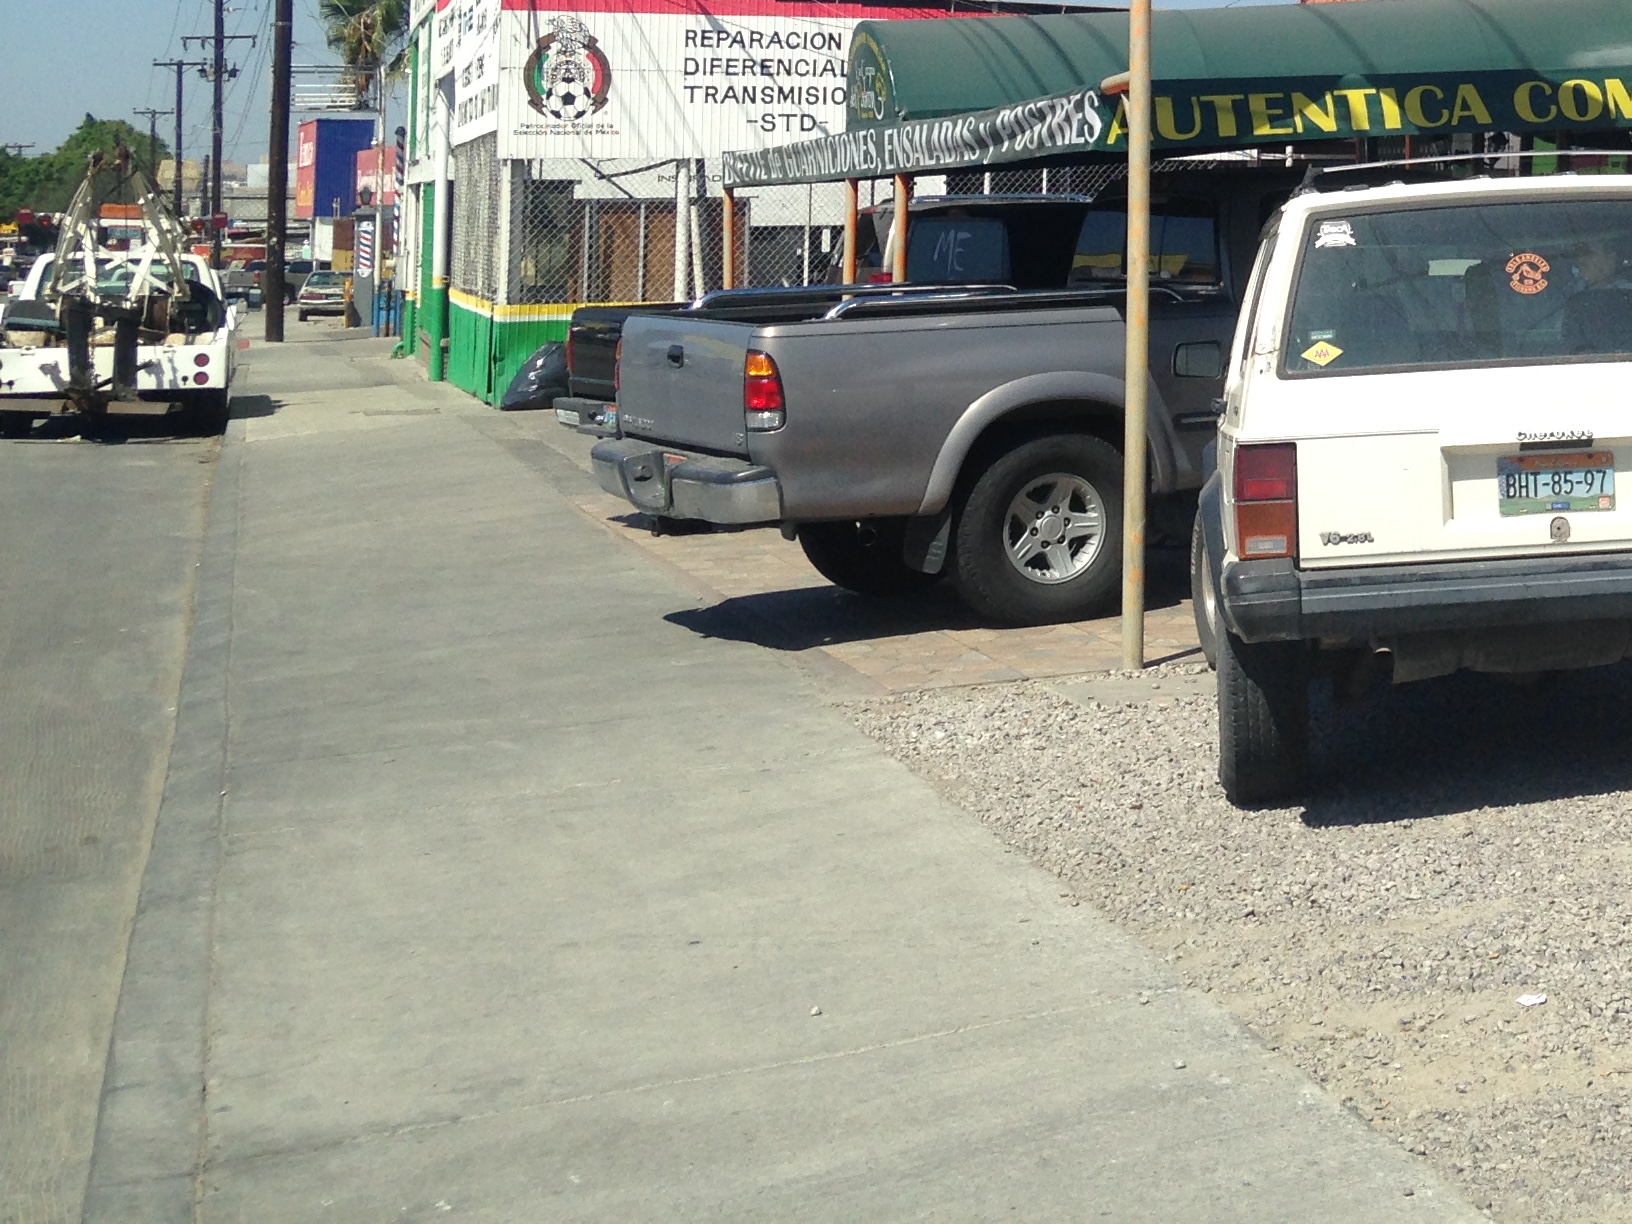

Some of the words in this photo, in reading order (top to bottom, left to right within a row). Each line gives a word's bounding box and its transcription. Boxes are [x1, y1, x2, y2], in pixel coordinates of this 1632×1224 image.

[685, 29, 842, 51] REPARACION
[684, 57, 848, 78] DIFERENCIAL
[884, 116, 980, 170] ENSALADAS
[995, 90, 1102, 153] POSTRES
[933, 229, 973, 276] ME
[1505, 469, 1607, 499] BHT-85-97
